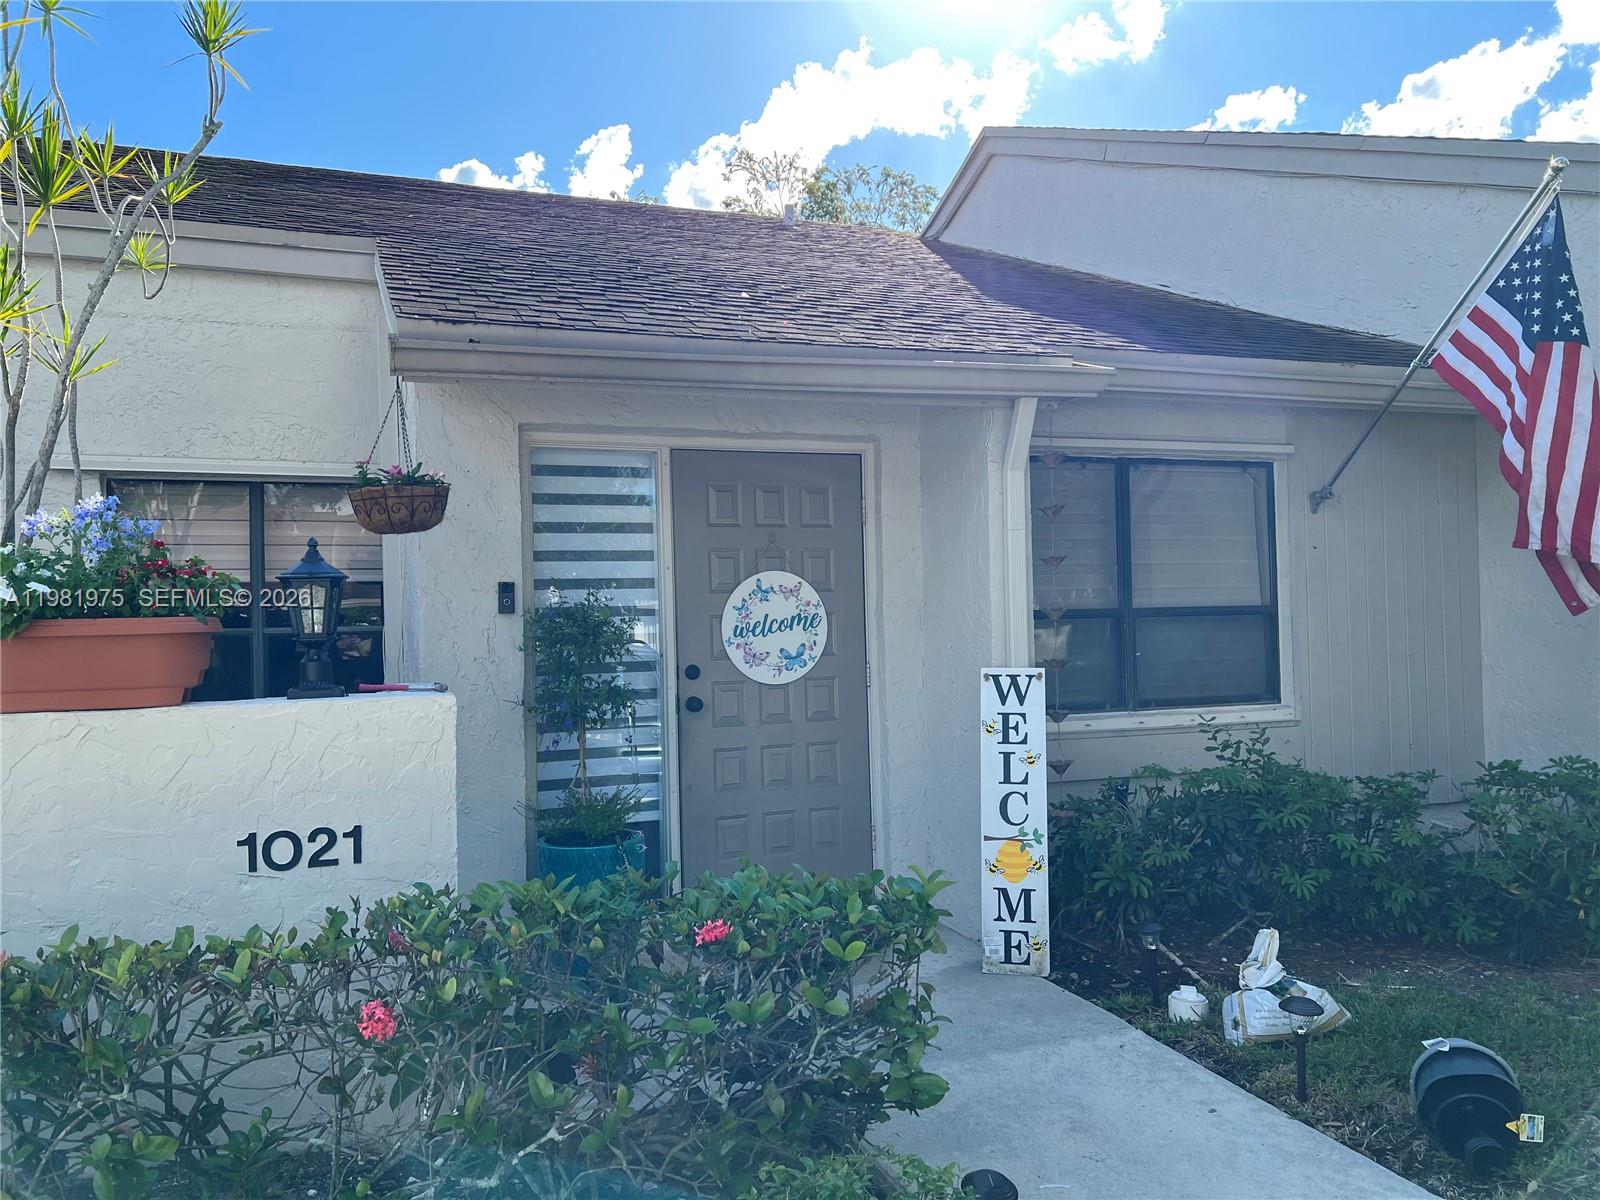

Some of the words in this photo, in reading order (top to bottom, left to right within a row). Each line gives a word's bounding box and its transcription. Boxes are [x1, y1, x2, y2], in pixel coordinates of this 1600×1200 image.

[732, 611, 823, 640] welcome
[990, 674, 1037, 966] WELCME
[236, 824, 363, 873] 1021
